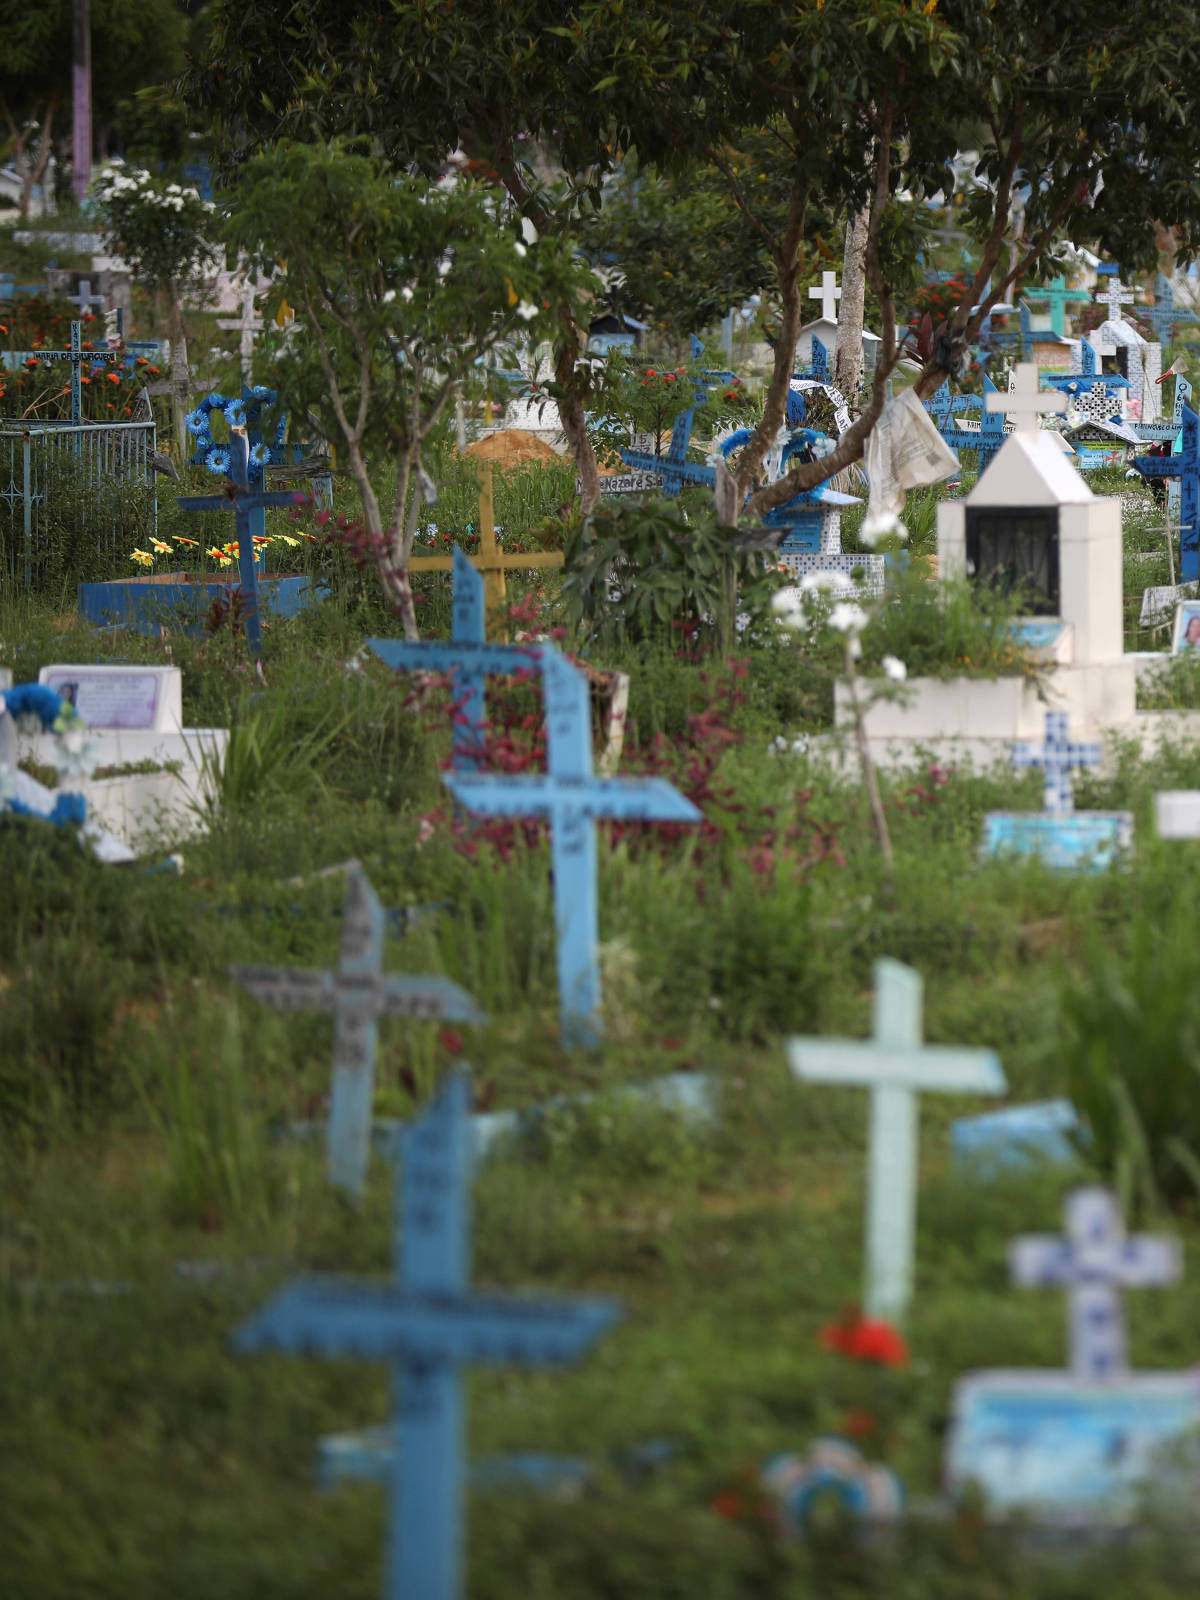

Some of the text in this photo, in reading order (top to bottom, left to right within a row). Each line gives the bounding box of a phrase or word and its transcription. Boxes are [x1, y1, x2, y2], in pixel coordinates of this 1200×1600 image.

[36, 352, 58, 360] MARIA
[61, 352, 72, 360] DA
[1178, 383, 1188, 392] Q
